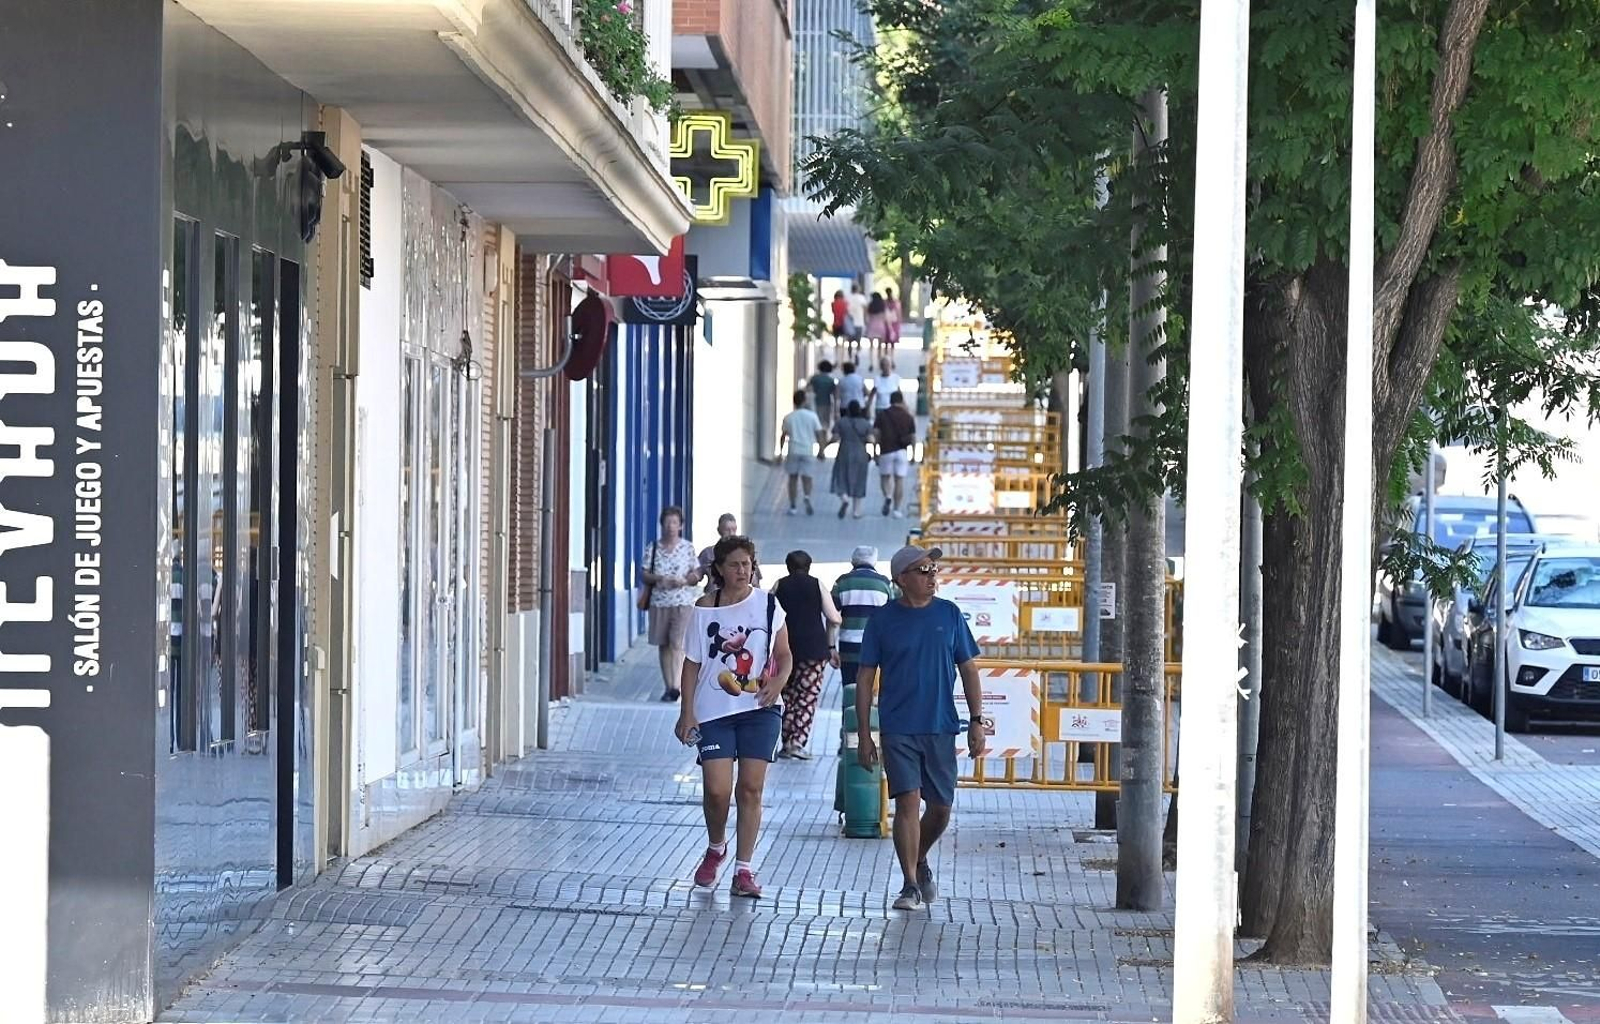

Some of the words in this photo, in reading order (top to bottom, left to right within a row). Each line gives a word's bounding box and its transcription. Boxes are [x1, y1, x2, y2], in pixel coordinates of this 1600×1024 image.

[76, 299, 104, 432] APUESTAS
[75, 436, 102, 455] Y
[75, 462, 102, 547] JUEGO
[75, 552, 101, 586] DE
[67, 594, 101, 677] SALÓN
